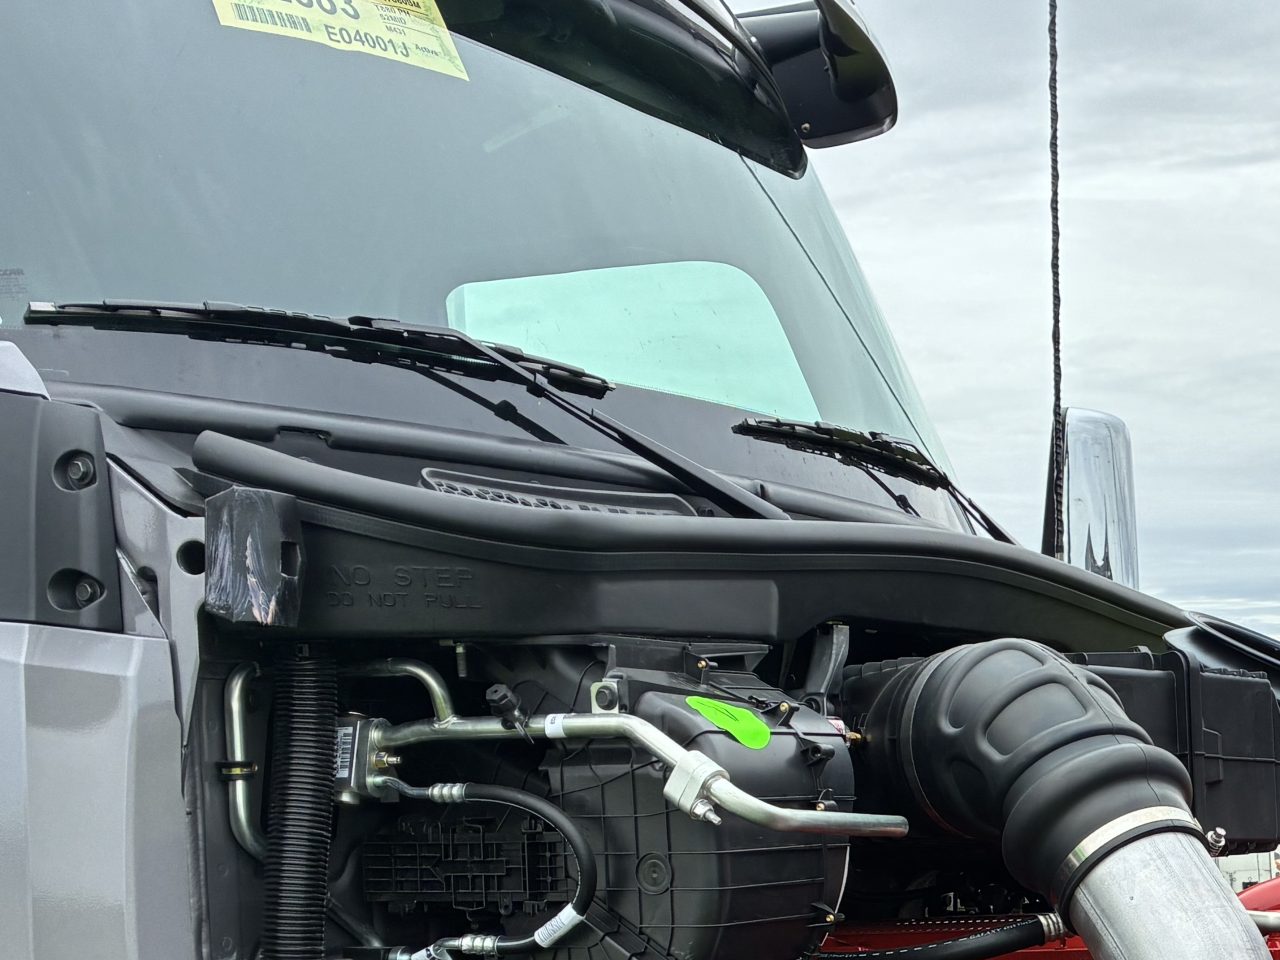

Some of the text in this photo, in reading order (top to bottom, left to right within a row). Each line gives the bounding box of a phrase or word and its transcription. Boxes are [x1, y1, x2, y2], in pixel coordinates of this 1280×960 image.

[324, 23, 410, 58] E04001J
[331, 564, 473, 588] NO STEP
[326, 592, 483, 609] DO NOT PULL
